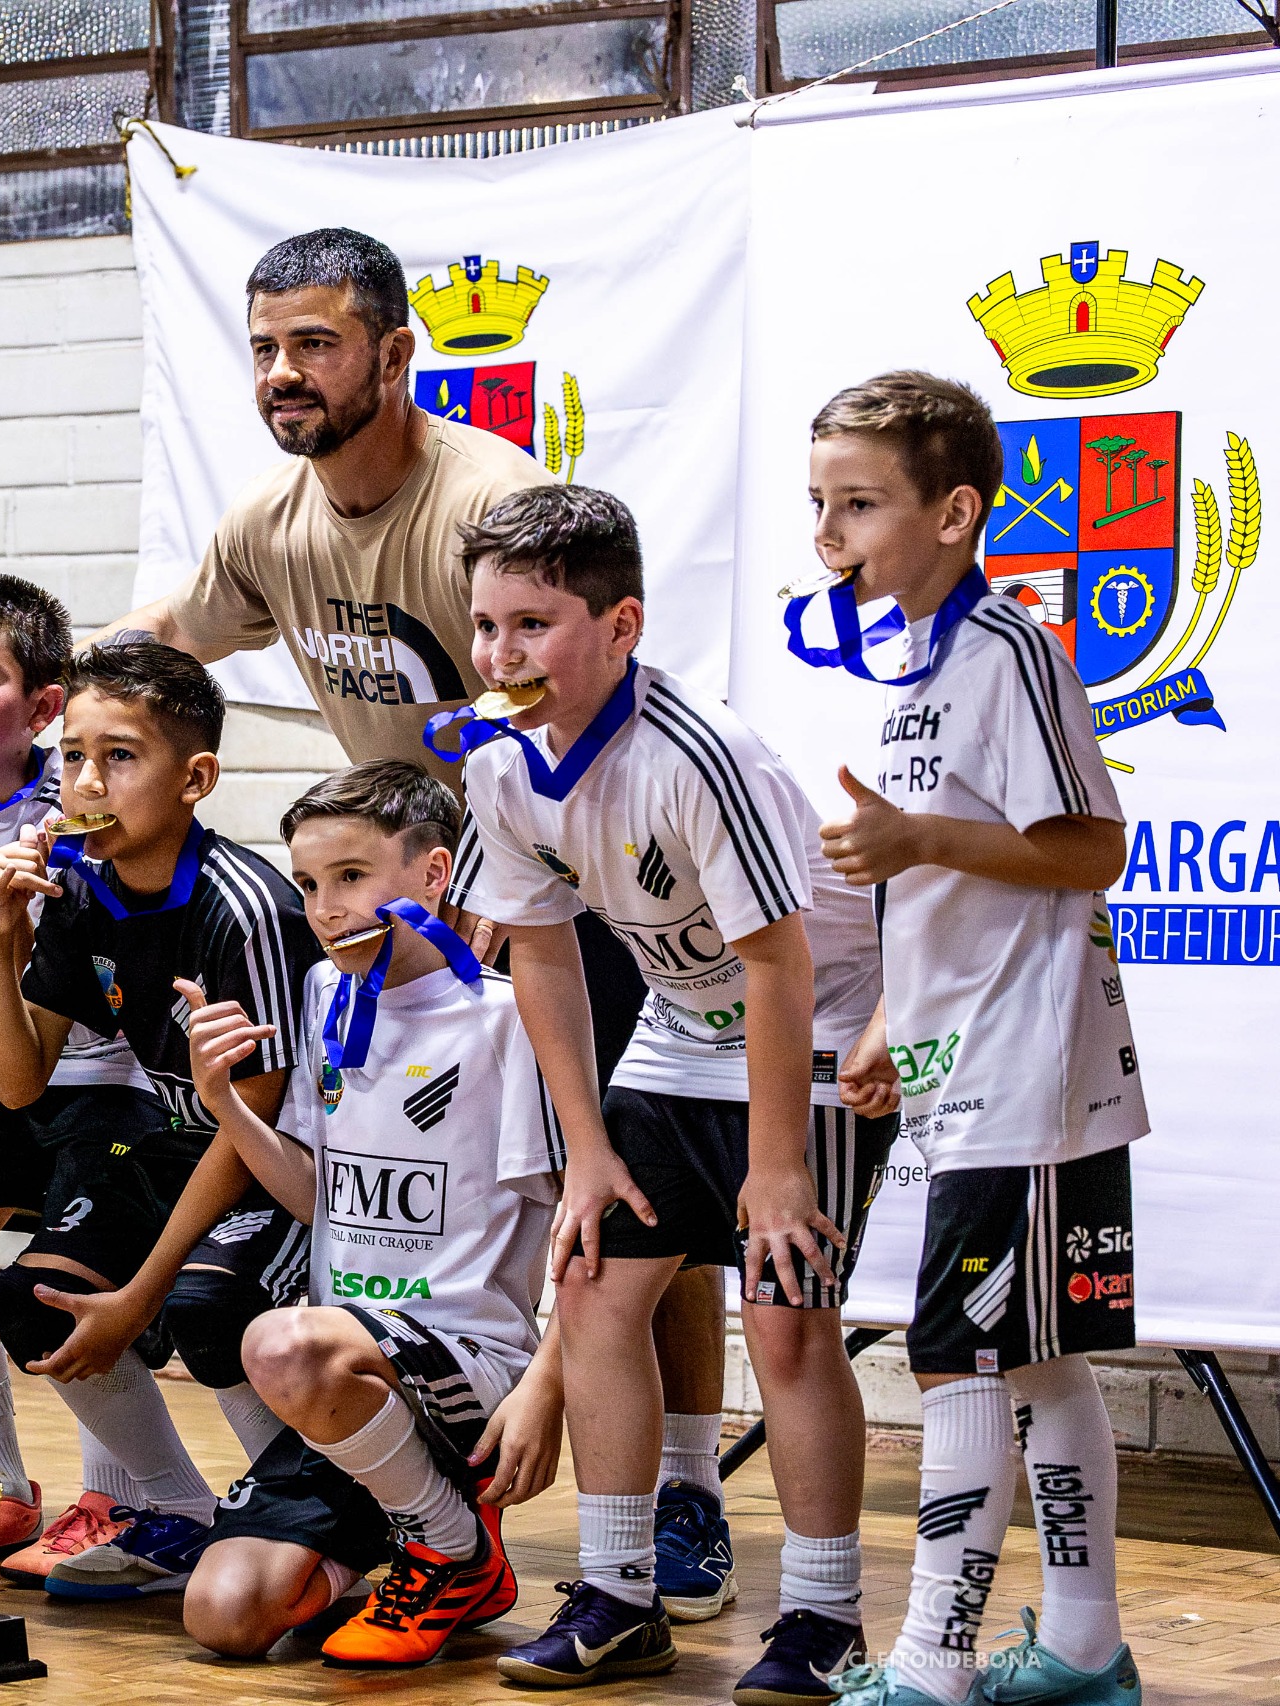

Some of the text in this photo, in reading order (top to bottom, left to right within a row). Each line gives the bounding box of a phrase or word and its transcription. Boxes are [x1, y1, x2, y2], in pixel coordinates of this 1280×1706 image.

[327, 598, 388, 637] THE
[292, 626, 393, 672] NORTH
[324, 664, 400, 705] FACE
[1091, 674, 1198, 730] ICTORIAM
[909, 755, 942, 792] RS
[1122, 820, 1280, 893] ARGA
[693, 962, 746, 990] CRAQUE
[938, 1098, 985, 1116] CRAQUE
[347, 1232, 376, 1247] MINI
[379, 1236, 434, 1253] CRAQUE
[329, 1261, 433, 1300] ESOJA
